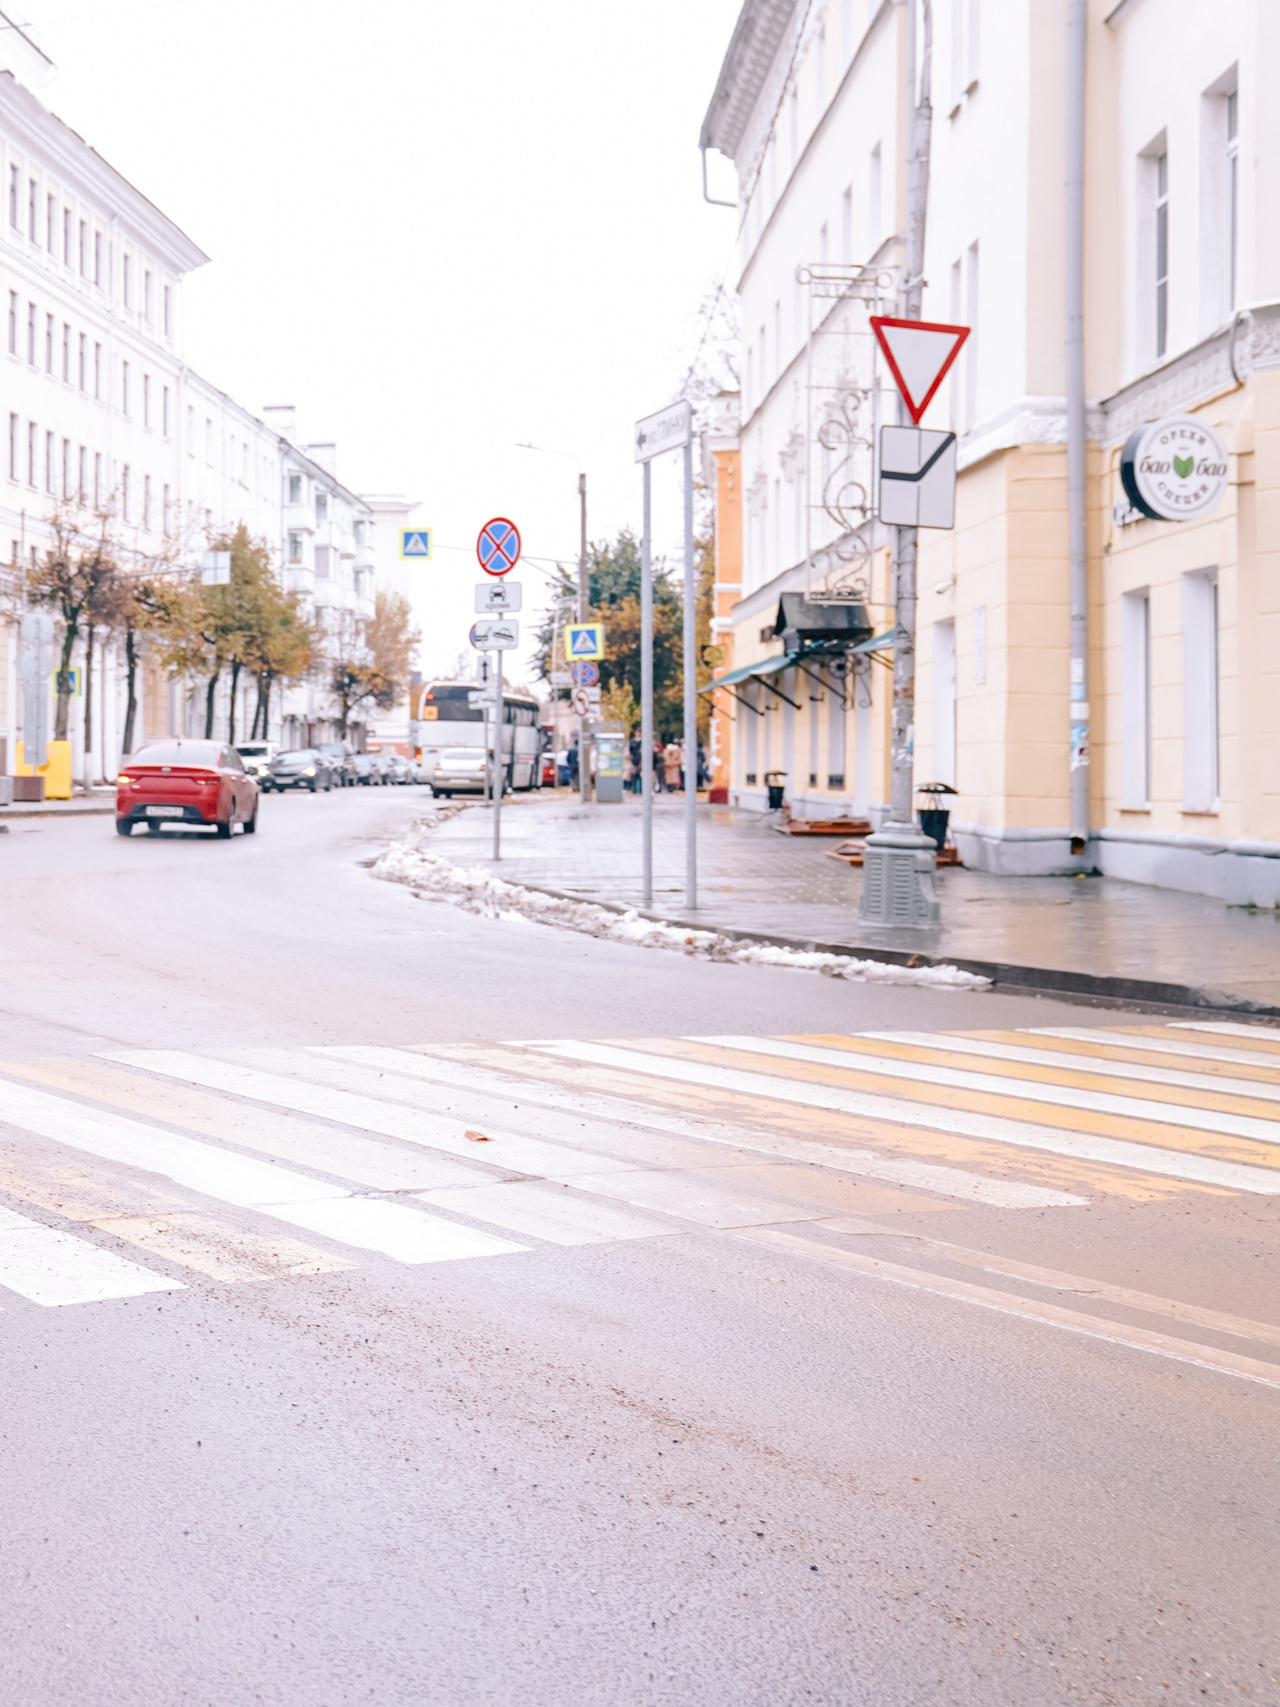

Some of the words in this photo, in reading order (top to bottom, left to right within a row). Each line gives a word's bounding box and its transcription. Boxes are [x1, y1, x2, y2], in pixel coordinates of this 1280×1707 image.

[1161, 430, 1206, 445] ОРЕХИ
[1140, 456, 1170, 474] бао
[1196, 457, 1227, 476] бао
[1158, 481, 1209, 504] СПЕЦИИ
